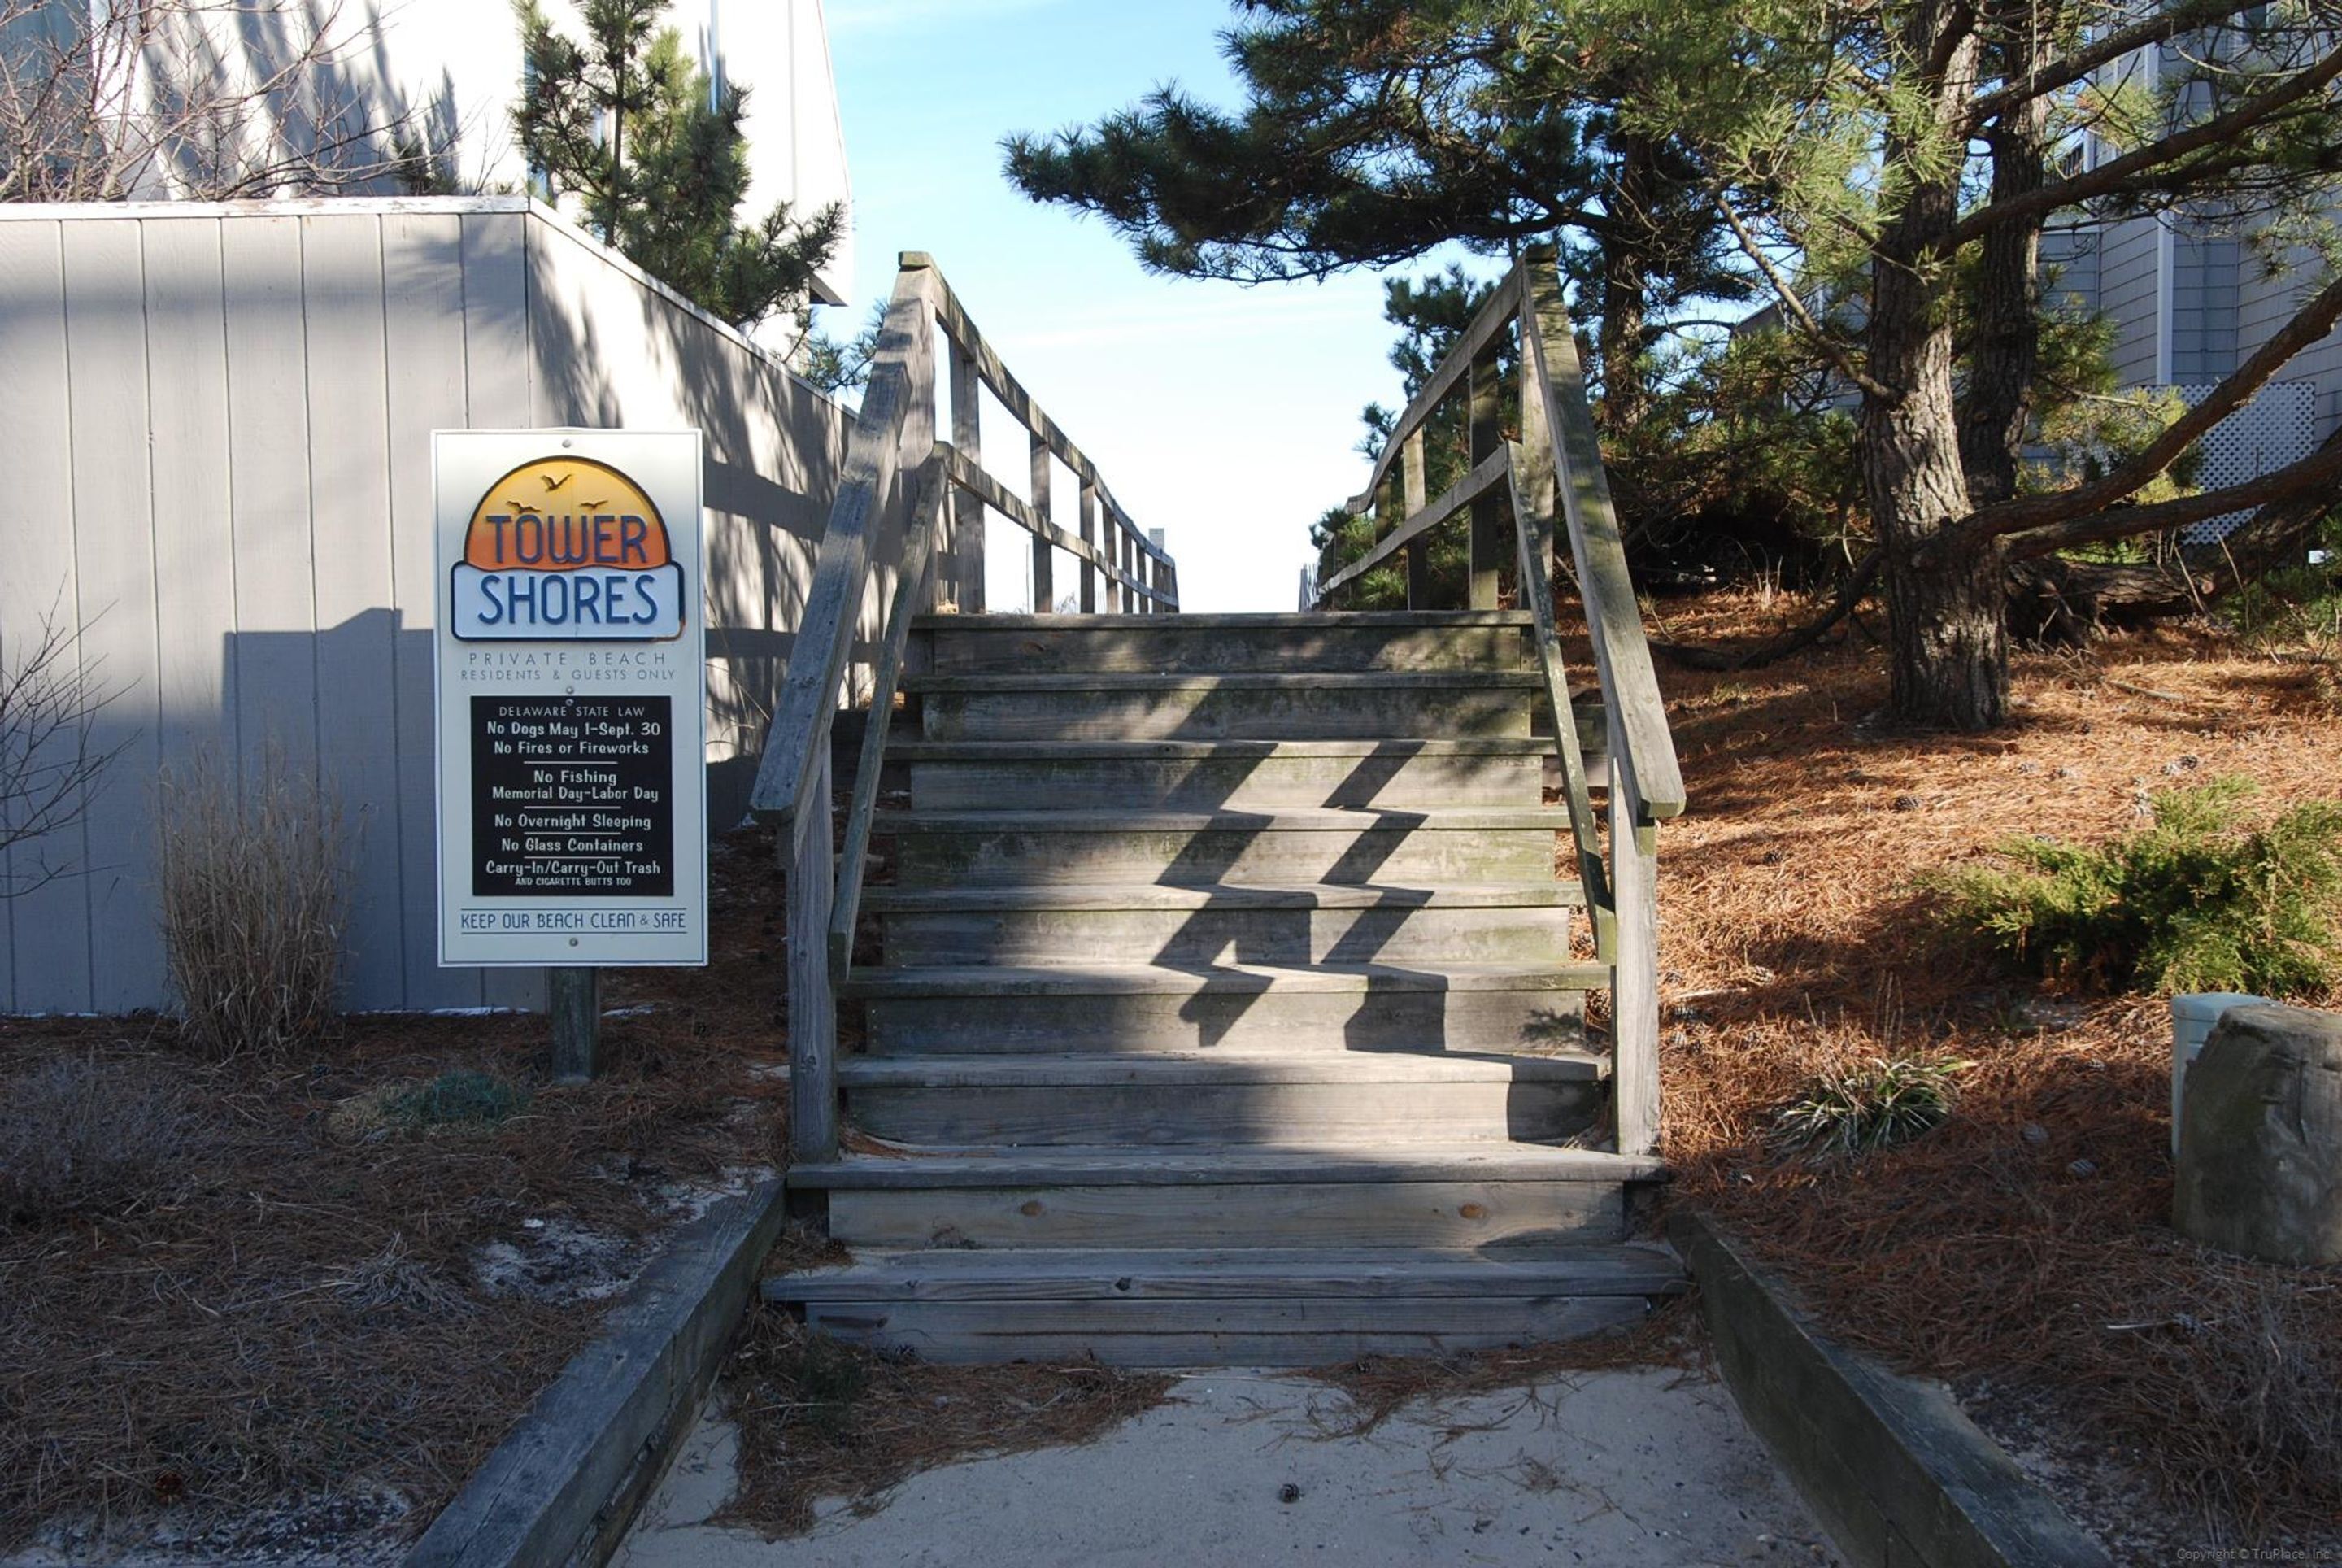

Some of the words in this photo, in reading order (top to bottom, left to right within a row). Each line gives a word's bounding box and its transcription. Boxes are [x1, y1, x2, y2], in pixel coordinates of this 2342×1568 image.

[485, 514, 648, 564] TOWER
[477, 574, 658, 625] SHORES
[469, 652, 568, 665] PRIVATE
[589, 652, 665, 664] BEACH
[460, 670, 541, 681] RESIDENTS
[552, 670, 561, 680] &
[572, 670, 627, 680] GUESTS
[637, 669, 676, 680] ONLY
[499, 707, 567, 716] DELAWARE
[576, 707, 609, 716] STATE
[618, 706, 645, 716] LAW
[487, 721, 505, 735] No
[511, 721, 545, 738] Dogs
[549, 722, 578, 738] May
[585, 722, 634, 738] 1-Sept.
[641, 722, 660, 735] 30
[494, 741, 511, 754] No
[518, 741, 552, 754] Fires
[559, 743, 572, 754] or
[580, 741, 649, 754] Fireworks
[534, 770, 553, 783] No
[561, 770, 617, 786] Fishing
[492, 786, 553, 799] Memorial
[559, 786, 628, 802] Day-Labor
[634, 787, 659, 802] Day
[494, 814, 512, 828] No
[518, 813, 586, 830] Overnight
[592, 814, 651, 830] Sleeping
[502, 838, 519, 852] No
[525, 838, 561, 852] Glass
[568, 838, 643, 852] Containers
[485, 860, 619, 877] Carry-In/Carry-Out
[625, 860, 660, 874] Trash
[515, 877, 533, 886] AND
[536, 877, 581, 886] CIGARETTE
[586, 877, 612, 886] BUTTS
[616, 877, 632, 886] TOO
[461, 913, 496, 929] KEEP
[503, 913, 529, 929] OUR
[537, 913, 584, 928] BEACH
[590, 912, 635, 928] CLEAN
[640, 915, 649, 926] &
[653, 912, 686, 928] SAFE
